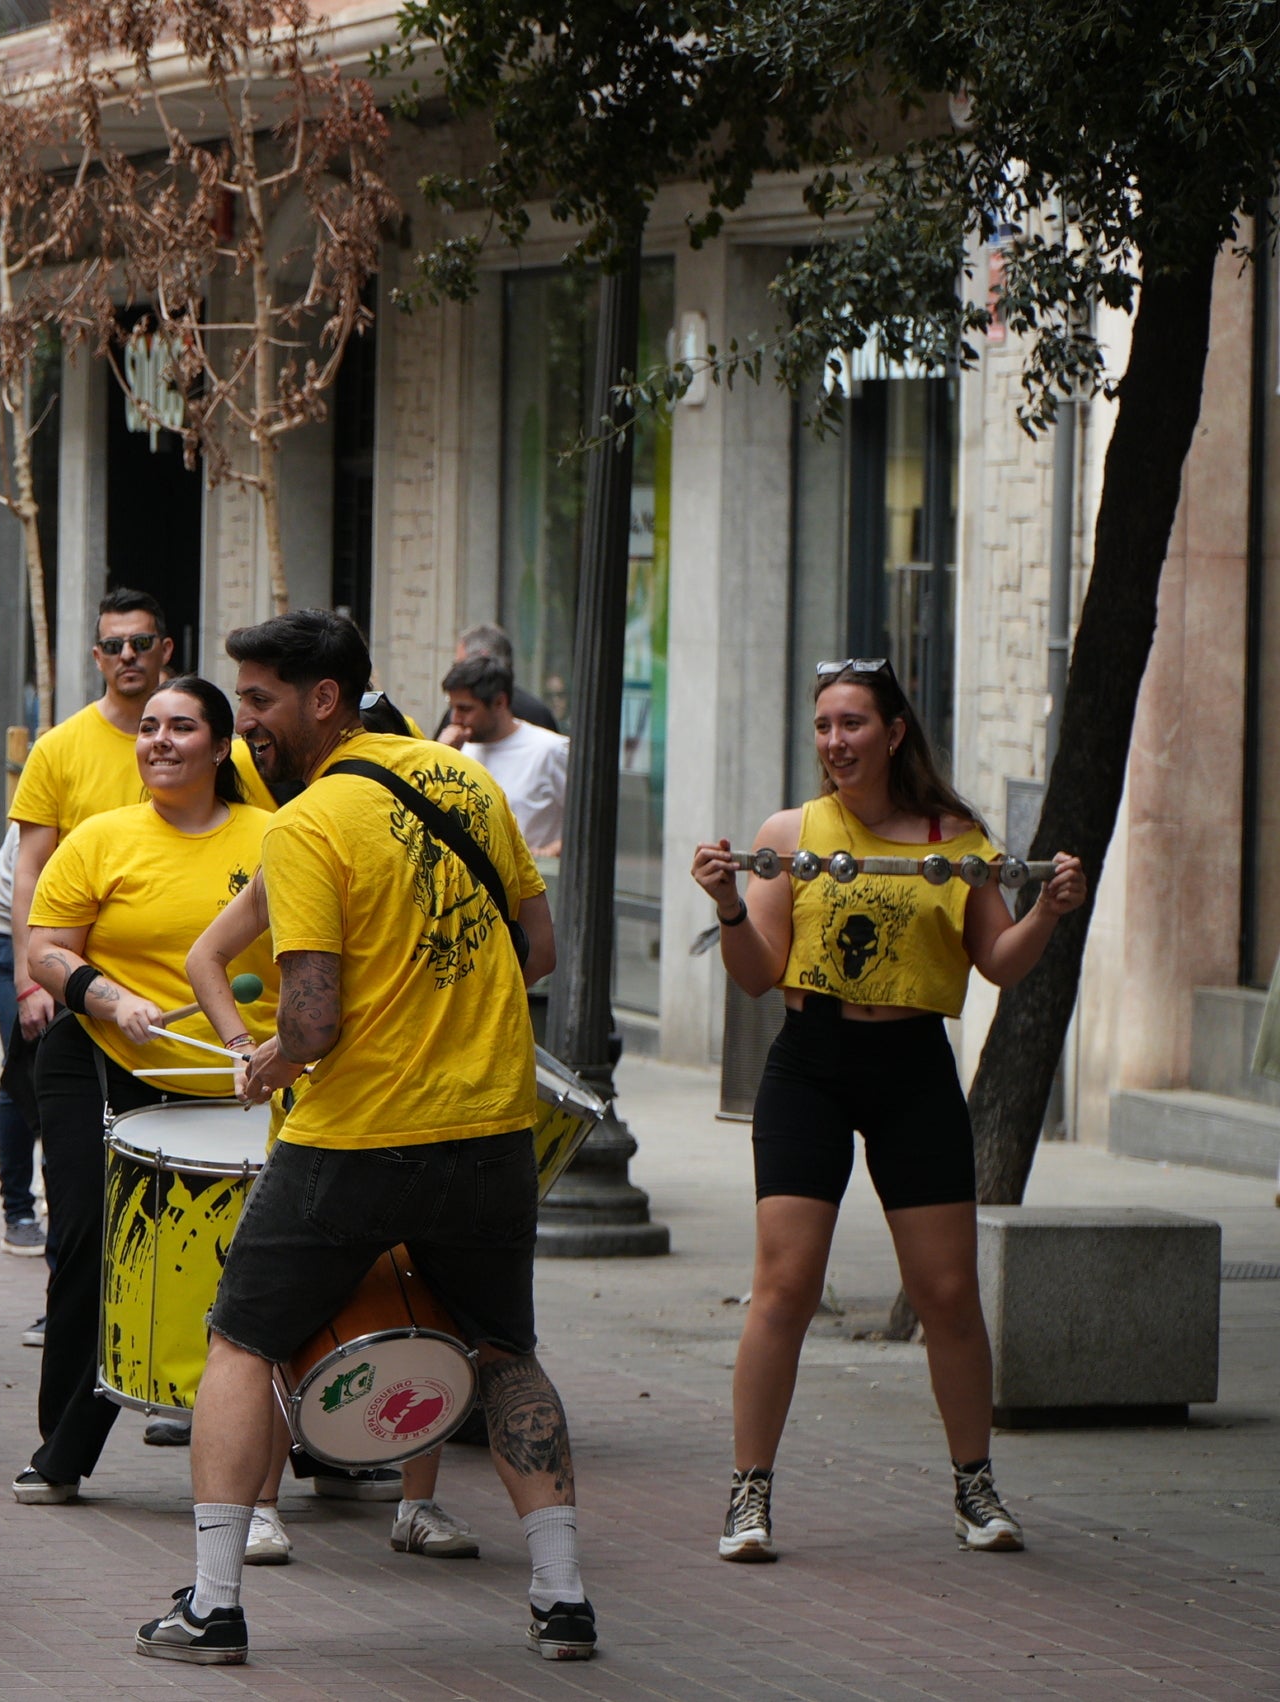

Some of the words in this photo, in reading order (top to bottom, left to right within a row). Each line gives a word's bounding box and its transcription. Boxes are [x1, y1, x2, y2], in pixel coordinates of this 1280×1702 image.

[410, 763, 493, 809] DIABLES
[799, 964, 828, 988] colla
[368, 1380, 413, 1415] COQUEIRO
[367, 1416, 387, 1440] TREPA
